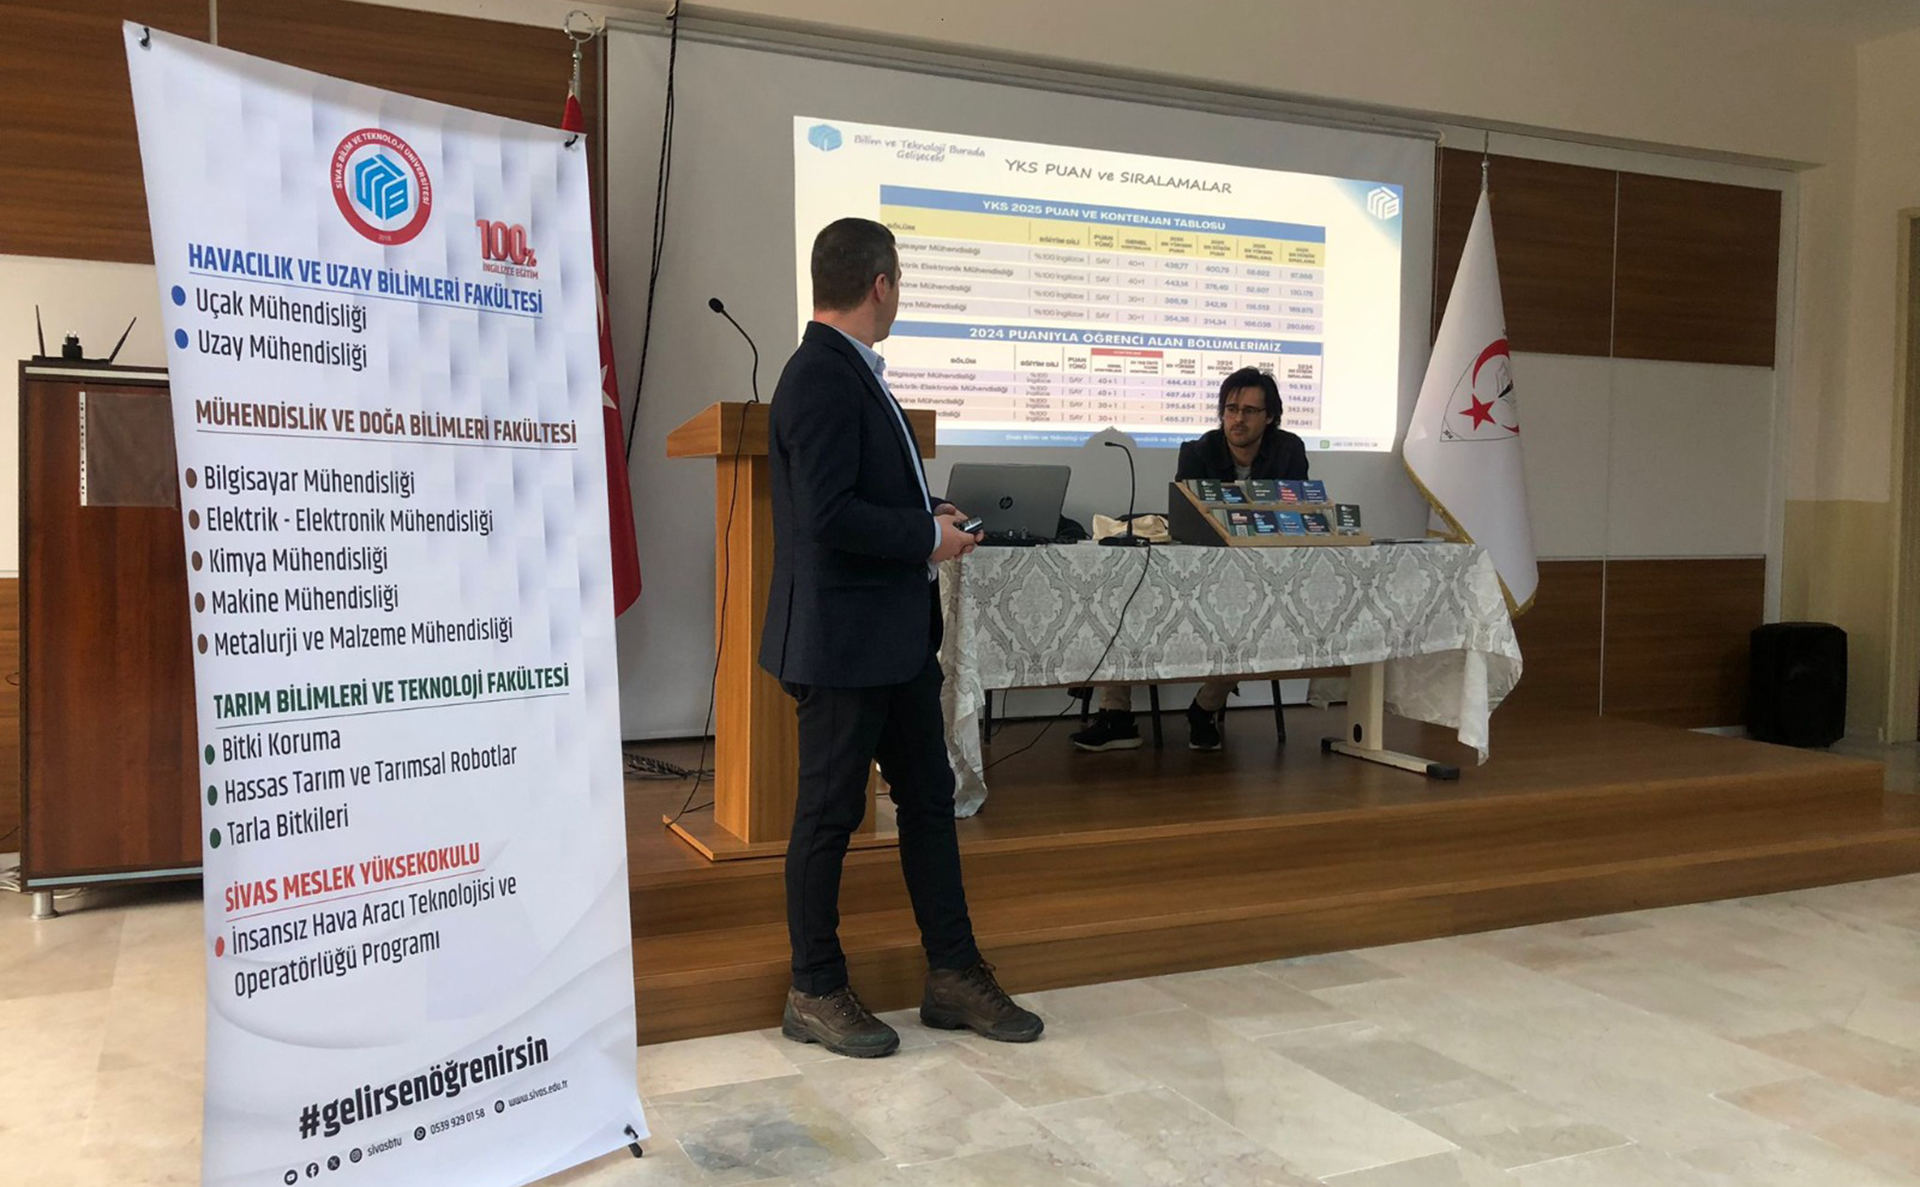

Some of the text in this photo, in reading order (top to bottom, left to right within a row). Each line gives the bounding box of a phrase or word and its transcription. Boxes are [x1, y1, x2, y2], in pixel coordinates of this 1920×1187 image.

[854, 134, 986, 158] Bilim ve Teknoloji Burada
[334, 132, 431, 206] SİVAS BİLİM VE TEKNOLOJİ ÜNİVERSİTESİ
[1005, 159, 1232, 194] YKS PUAN ve SIRALAMALAR
[982, 200, 1226, 231] YKS 2025 PUAN VE KONTENJAN TABLOSU
[476, 219, 537, 267] 100%
[929, 244, 981, 256] Mühendisliği
[188, 243, 543, 314] HAVACILIK VE UZAY BİLİMLERİ FAKÜLTESİ
[898, 280, 918, 289] kine
[920, 281, 971, 293] Mühendisliği
[921, 263, 962, 272] Elektronik
[963, 264, 1014, 276] Mühendisliği
[196, 288, 367, 333] Uçak Mühendisliği
[916, 300, 967, 312] Mühendisliği
[198, 329, 367, 372] Uzay Mühendisliği
[969, 327, 1282, 352] 2024 PUANIYLA ÖĞRENCİ ALAN BÖLÜMLERİMİZ
[927, 371, 976, 381] Mühendisliği
[961, 384, 1008, 394] Mühendisliği
[917, 397, 965, 407] Mühendisliği
[195, 396, 578, 444] MÜHENDİSLİK VE DOĞA BİLİMLERİ FAKÜLTESİ
[204, 465, 416, 499] Bilgisayar Mühendisliği
[206, 507, 278, 531] Elektrik
[296, 508, 386, 532] Elektronik
[391, 509, 494, 536] Mühendisliği
[209, 546, 388, 577] Kimya Mühendisliği
[212, 584, 399, 614] Makine Mühendisliği
[214, 617, 513, 656] Metalurji ve Malzeme Mühendisliği
[213, 662, 570, 719] TARIM BİLİMLERİ VE TEKNOLOJİ FAKÜLTESİ
[222, 729, 342, 762] Bitki Koruma
[225, 744, 517, 805] Hassas Tarım ve Tarımsal Robotlar
[226, 803, 349, 847] Tarla Bitkileri
[225, 842, 480, 913] SİVAS MESLEK YÜKSEKOKULU
[232, 875, 517, 955] İnsansız Hava Aracı Teknolojisi ve
[234, 930, 440, 999] Operatörlüğü Programı
[299, 1035, 549, 1139] #gelirsenöğrenirsin
[367, 1137, 403, 1158] sivasbtu
[430, 1118, 450, 1136] 0539
[451, 1113, 467, 1129] 929
[475, 1108, 486, 1123] 58
[508, 1079, 569, 1108] www.sivas.edu.tr
